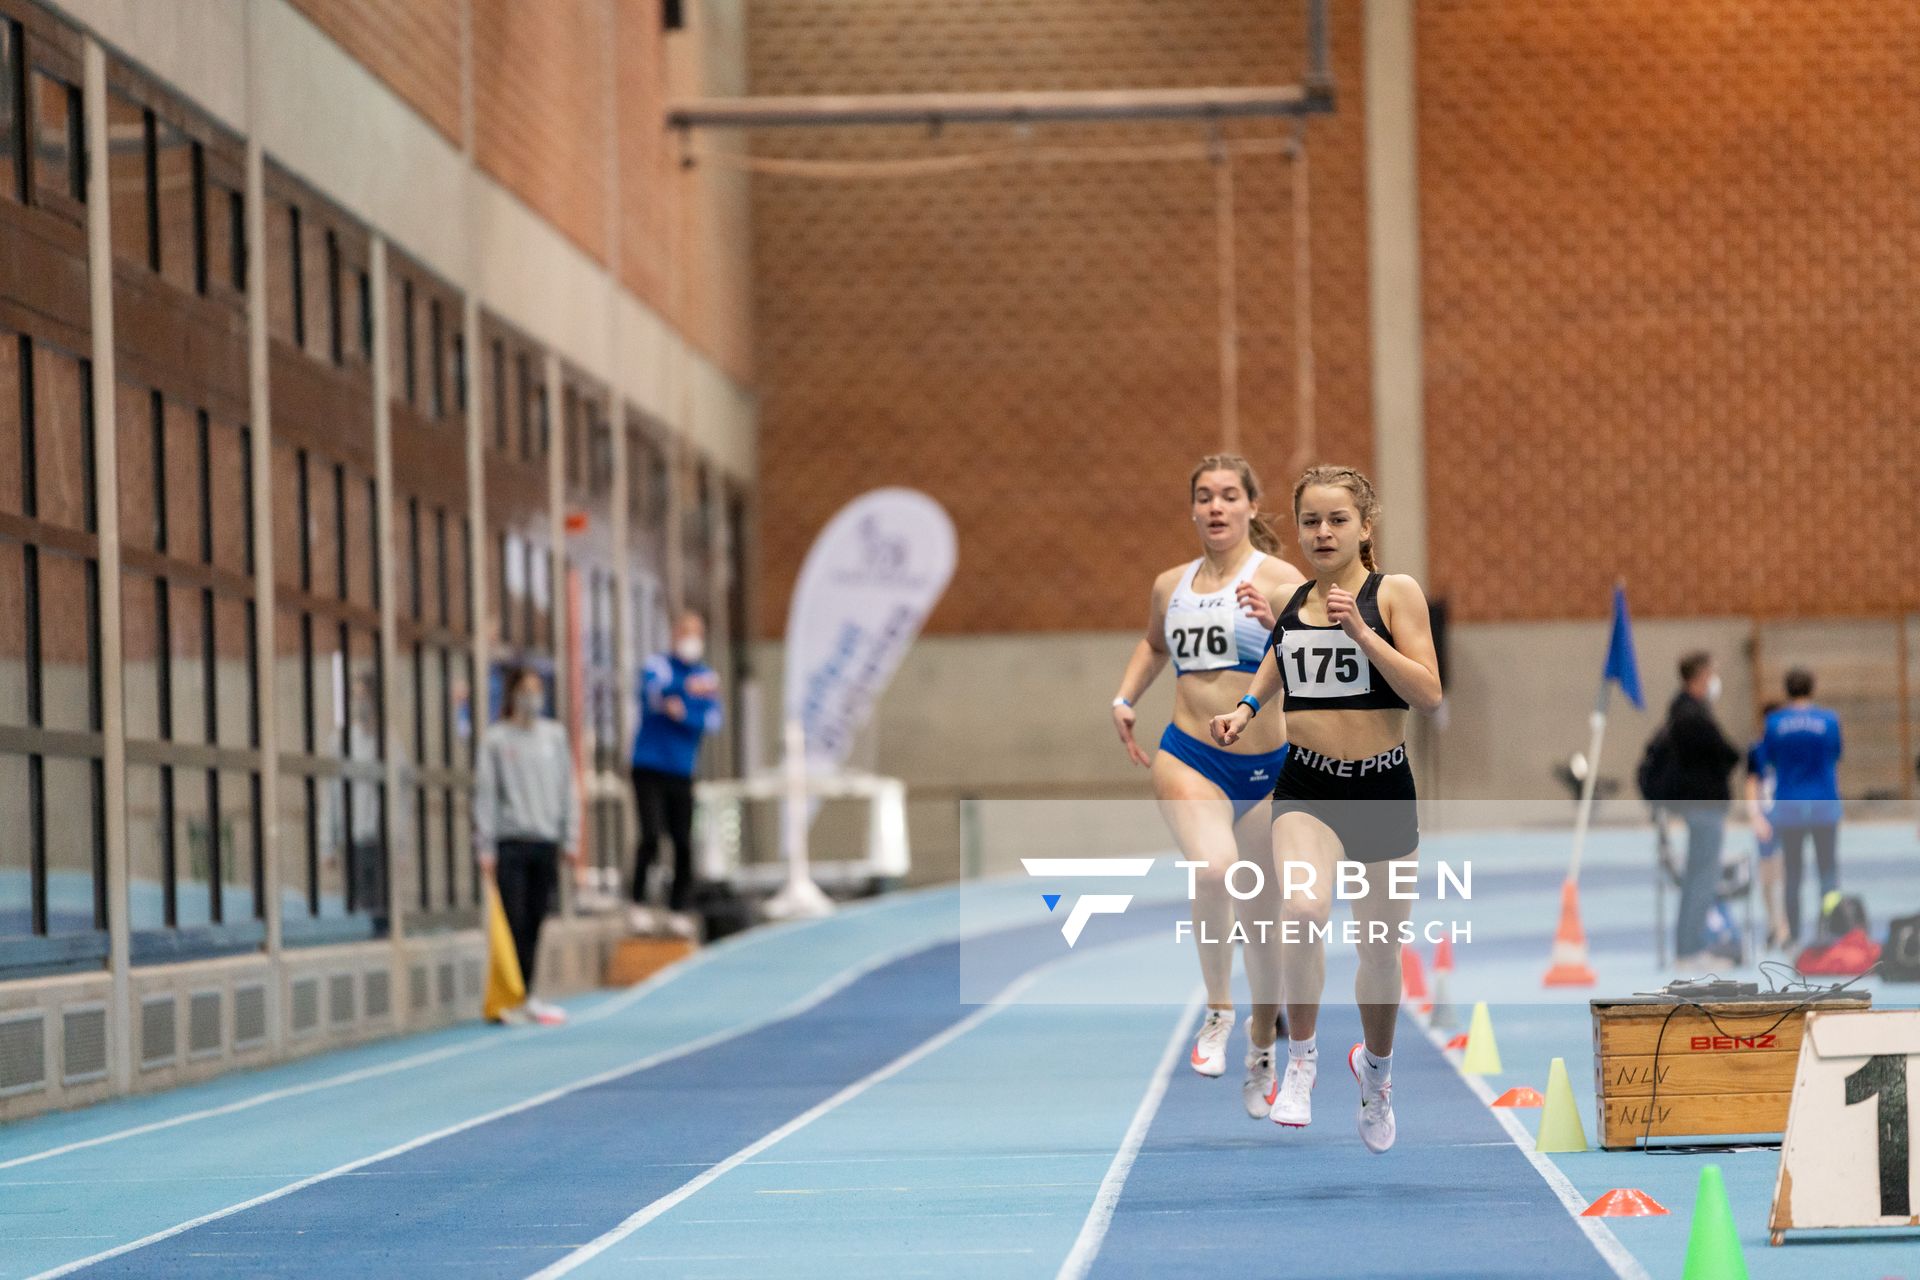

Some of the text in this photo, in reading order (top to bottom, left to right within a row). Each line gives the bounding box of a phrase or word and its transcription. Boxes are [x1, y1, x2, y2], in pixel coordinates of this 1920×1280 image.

[1172, 625, 1228, 658] 276
[1291, 646, 1359, 684] 175
[1294, 745, 1404, 778] NIKE PRO
[1690, 1034, 1777, 1051] BENZ
[1617, 1064, 1670, 1086] NLV
[1619, 1105, 1672, 1127] NLV
[1844, 1053, 1911, 1217] 1
